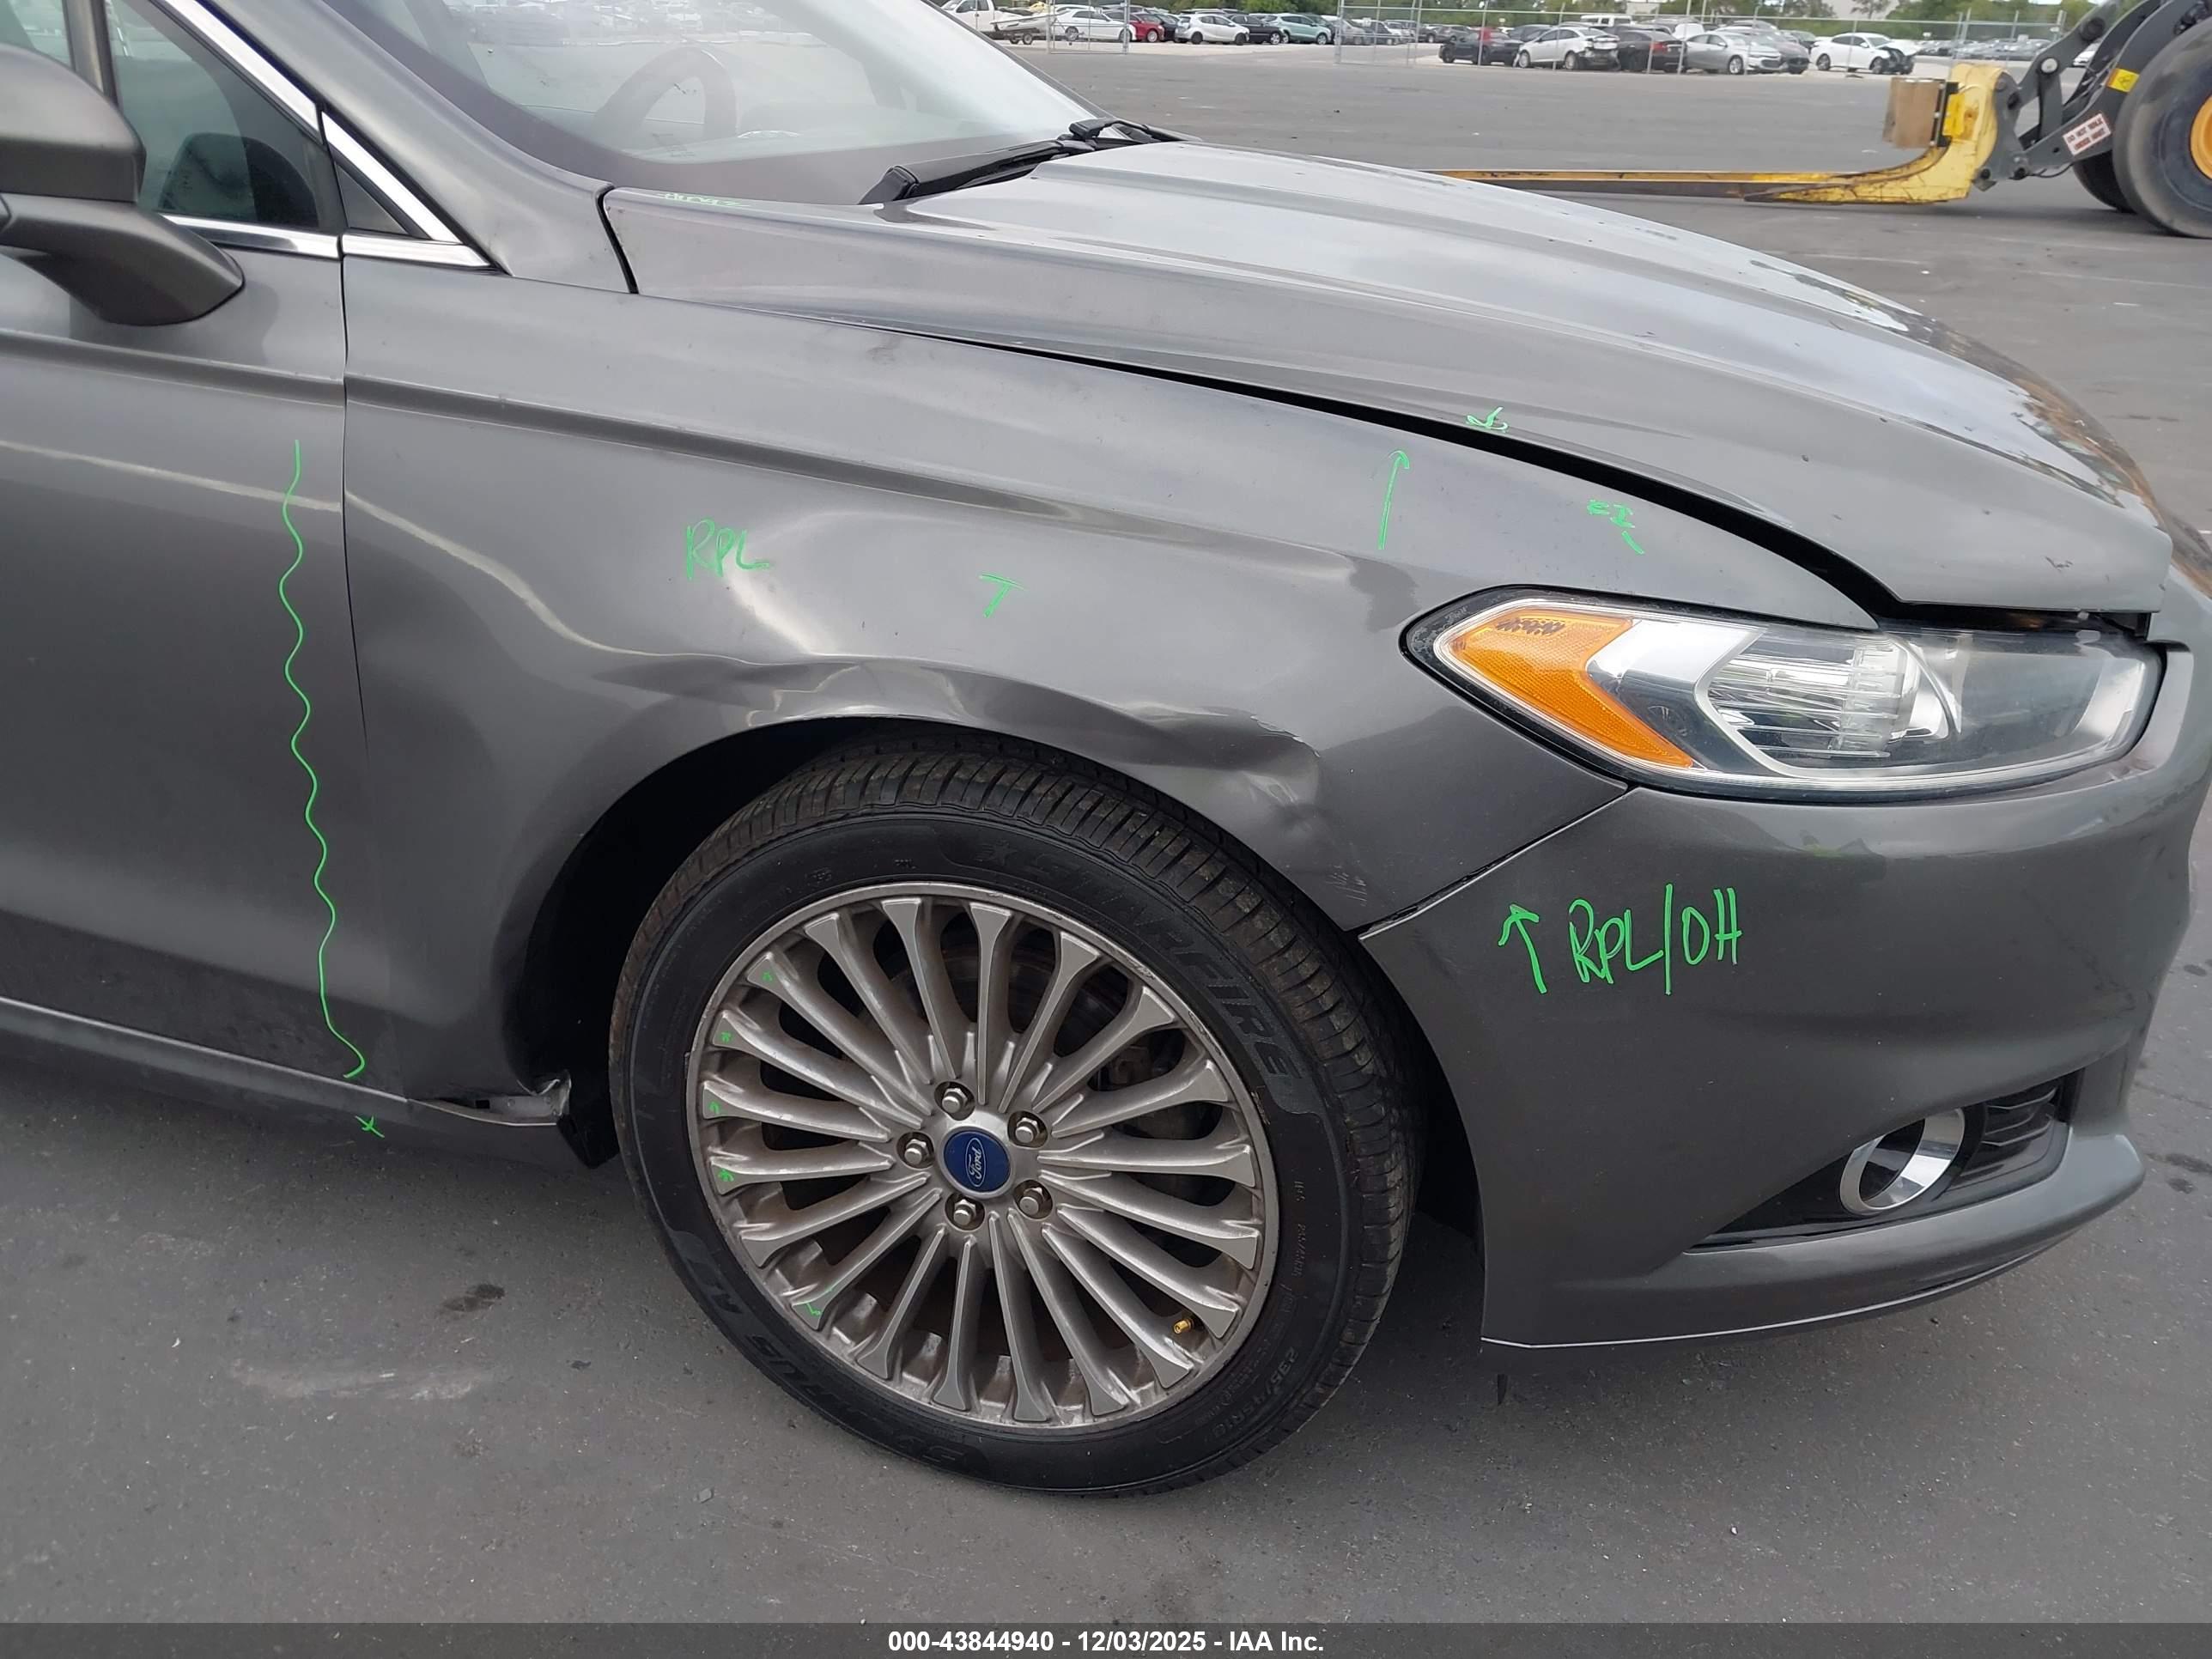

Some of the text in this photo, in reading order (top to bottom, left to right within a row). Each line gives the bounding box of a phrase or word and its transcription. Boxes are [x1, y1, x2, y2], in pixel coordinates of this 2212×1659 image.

[686, 517, 770, 580] RPL
[1569, 883, 1743, 996] RPL/OH
[969, 1146, 982, 1180] Ford
